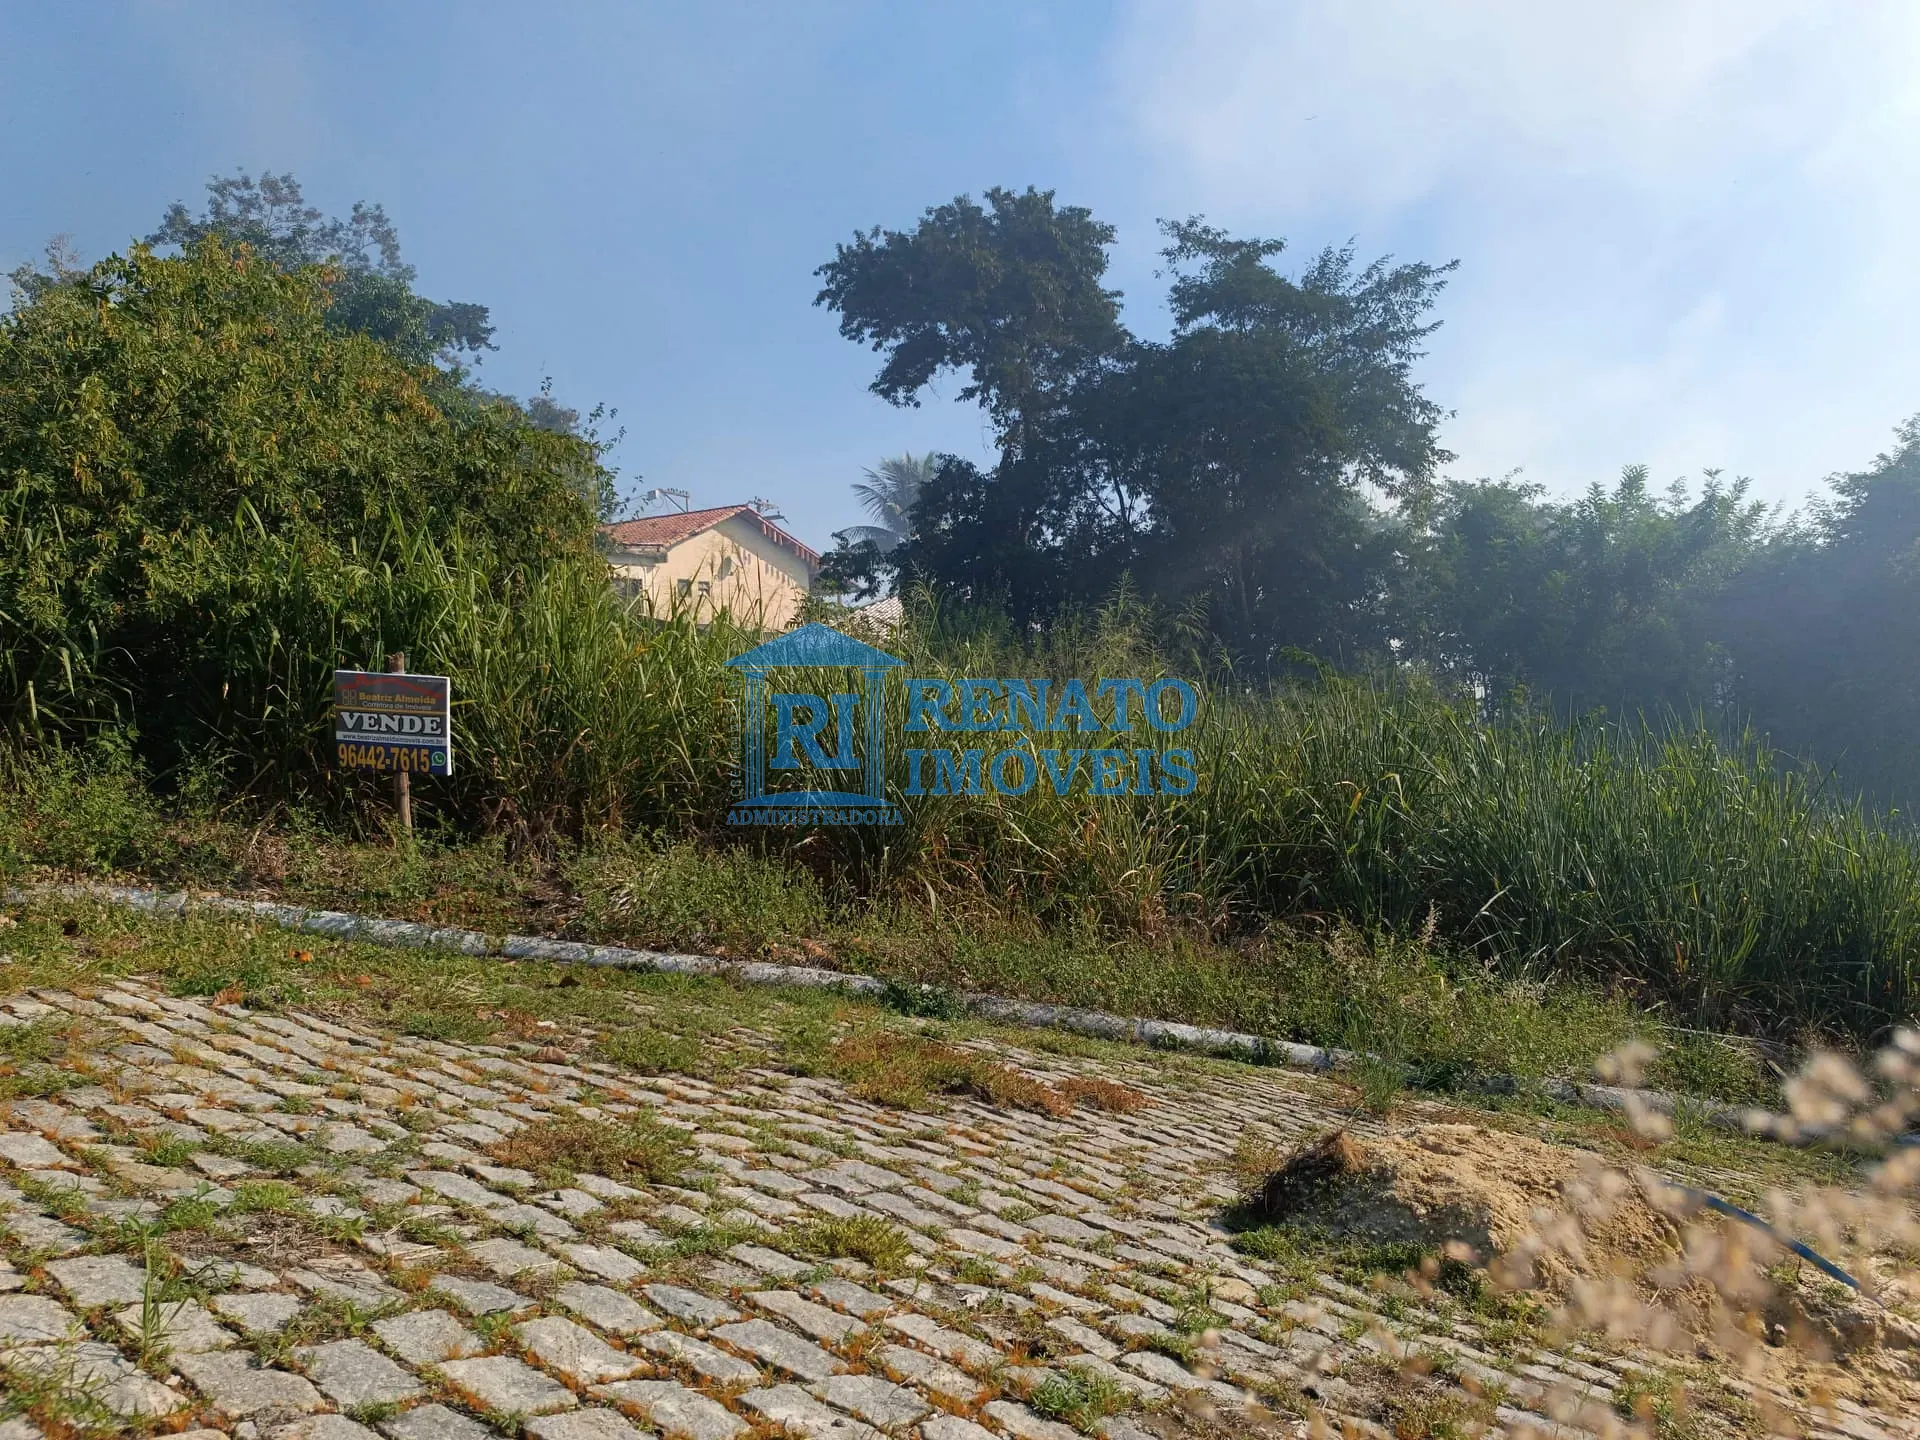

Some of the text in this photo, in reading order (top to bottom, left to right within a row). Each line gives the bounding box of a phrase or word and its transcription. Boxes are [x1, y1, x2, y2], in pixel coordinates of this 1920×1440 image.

[358, 692, 436, 705] Beatriz Almeida
[340, 711, 442, 735] VENDE
[338, 743, 430, 772] 96442-7615
